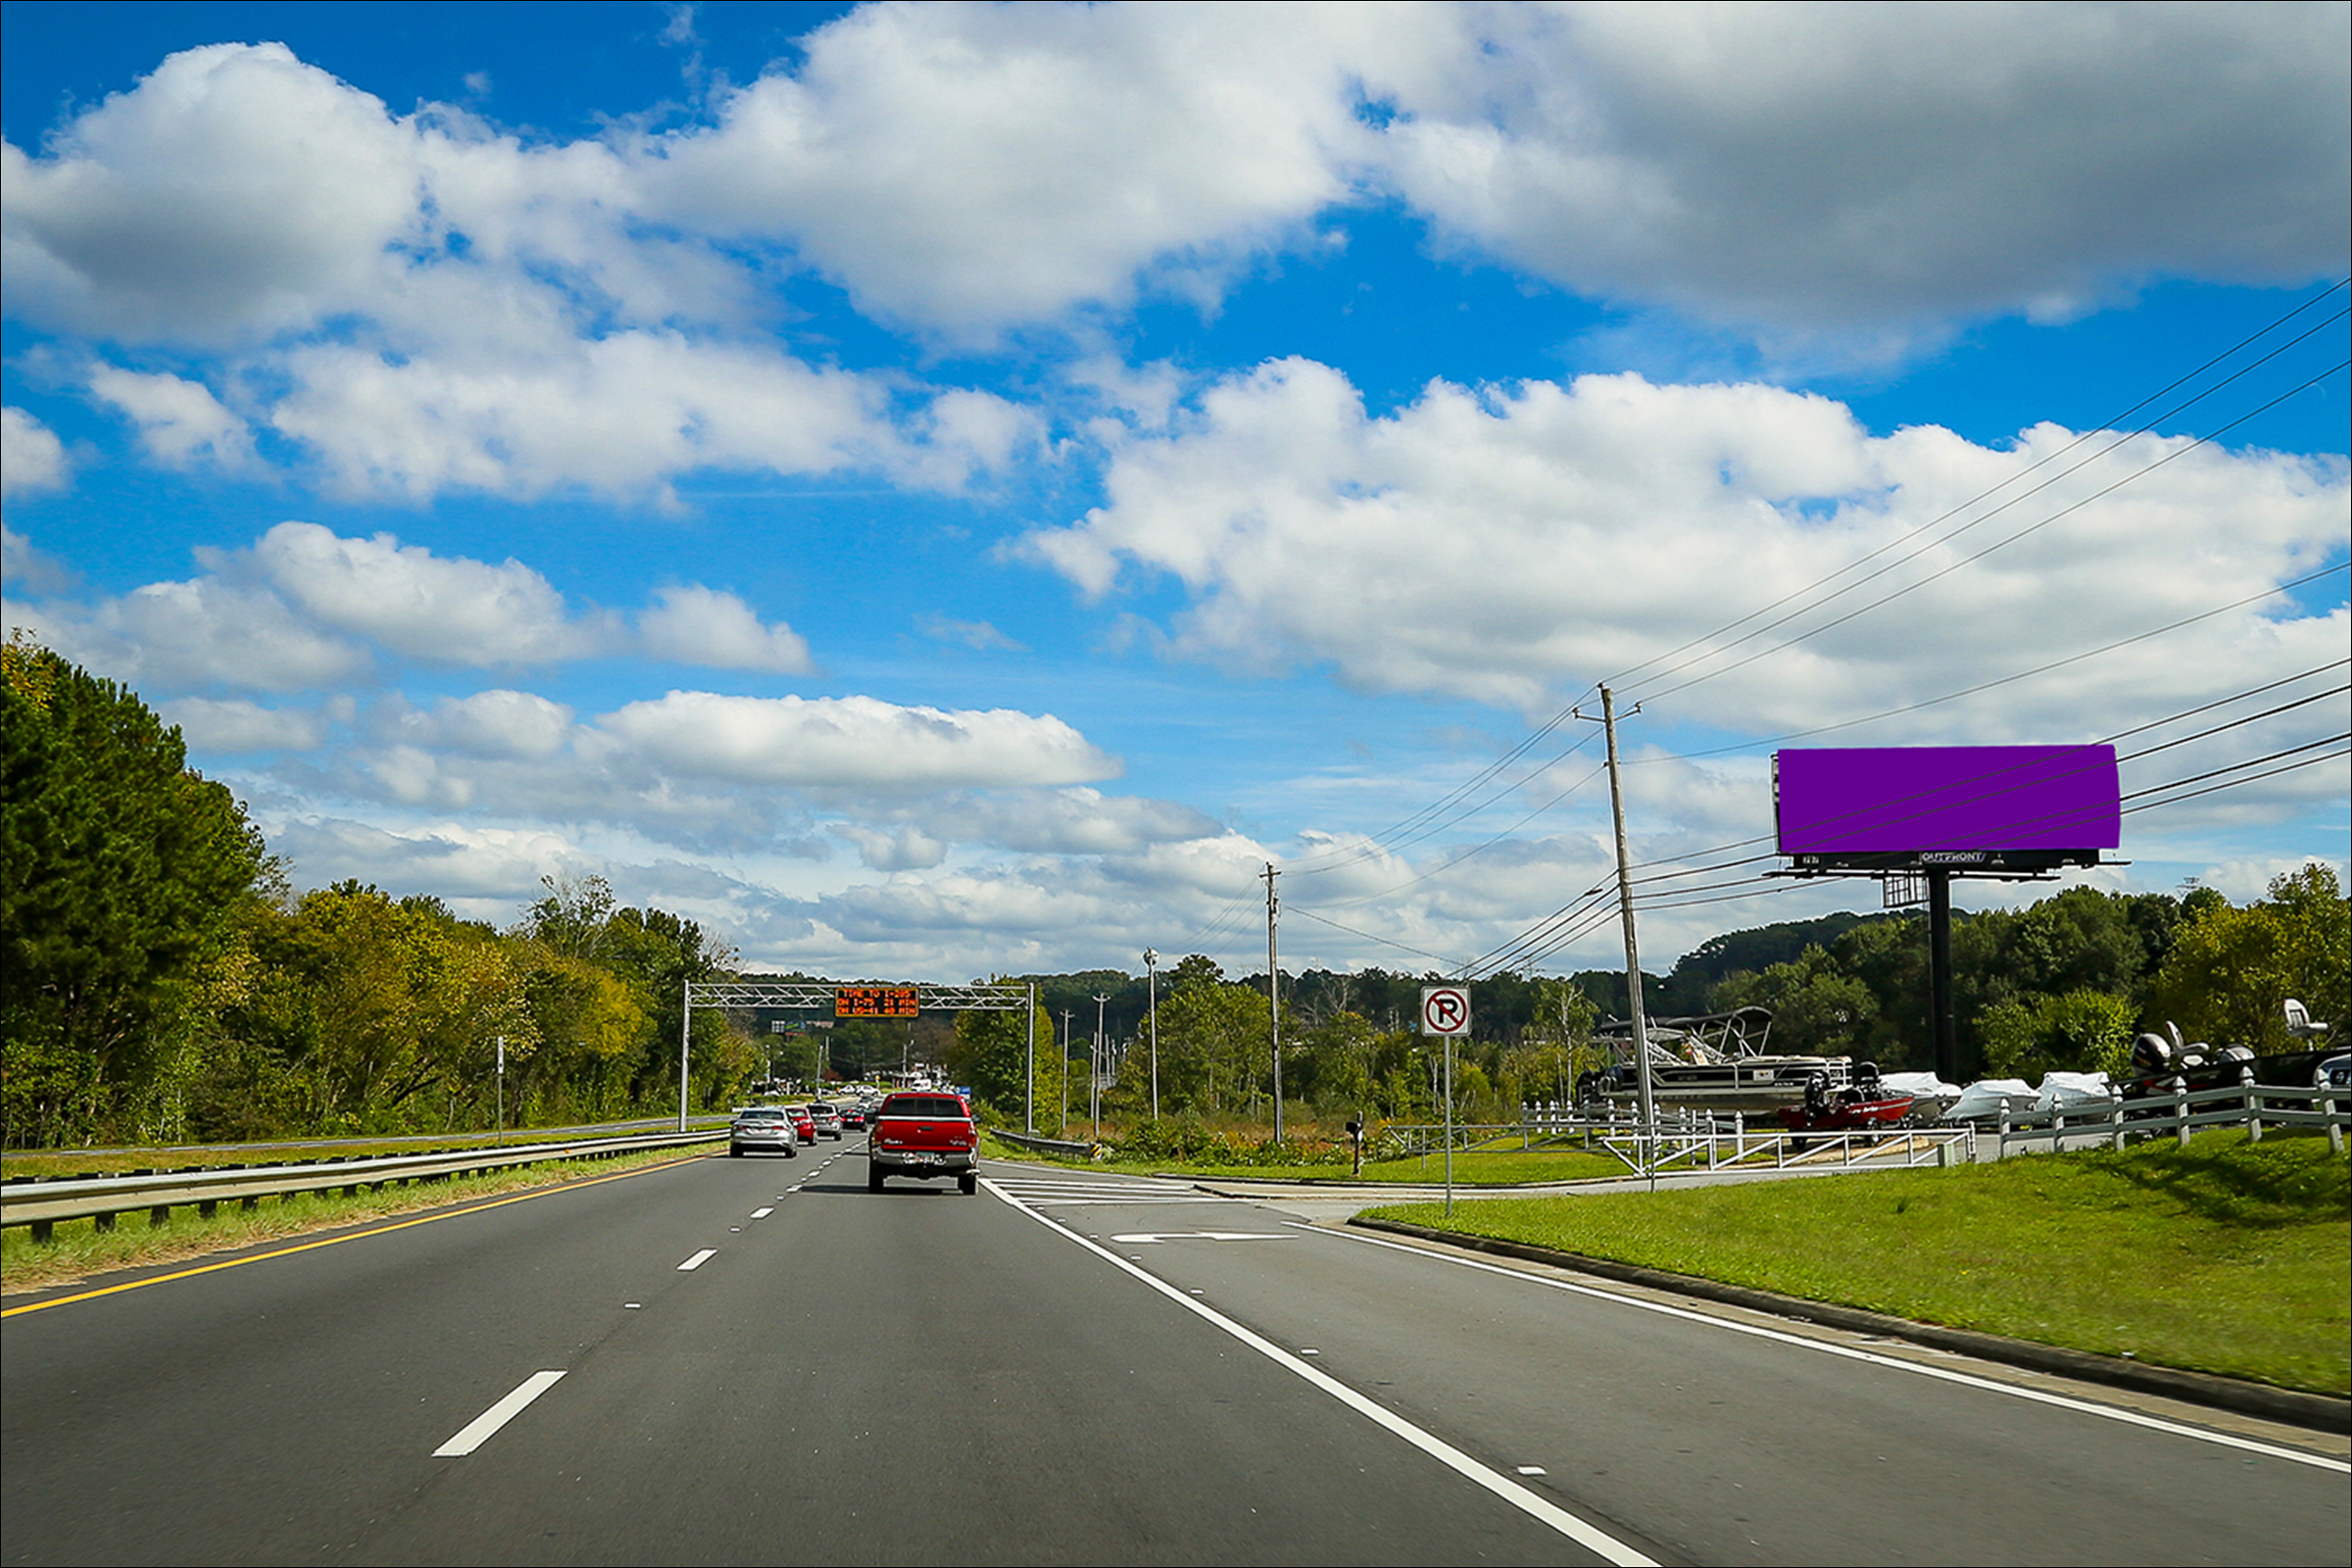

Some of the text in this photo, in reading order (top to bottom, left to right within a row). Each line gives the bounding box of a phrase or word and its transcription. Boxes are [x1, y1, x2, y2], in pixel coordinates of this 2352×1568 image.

[837, 998, 850, 1006] ON
[854, 998, 875, 1006] I-75
[899, 998, 917, 1006] MIN
[1439, 998, 1458, 1024] P
